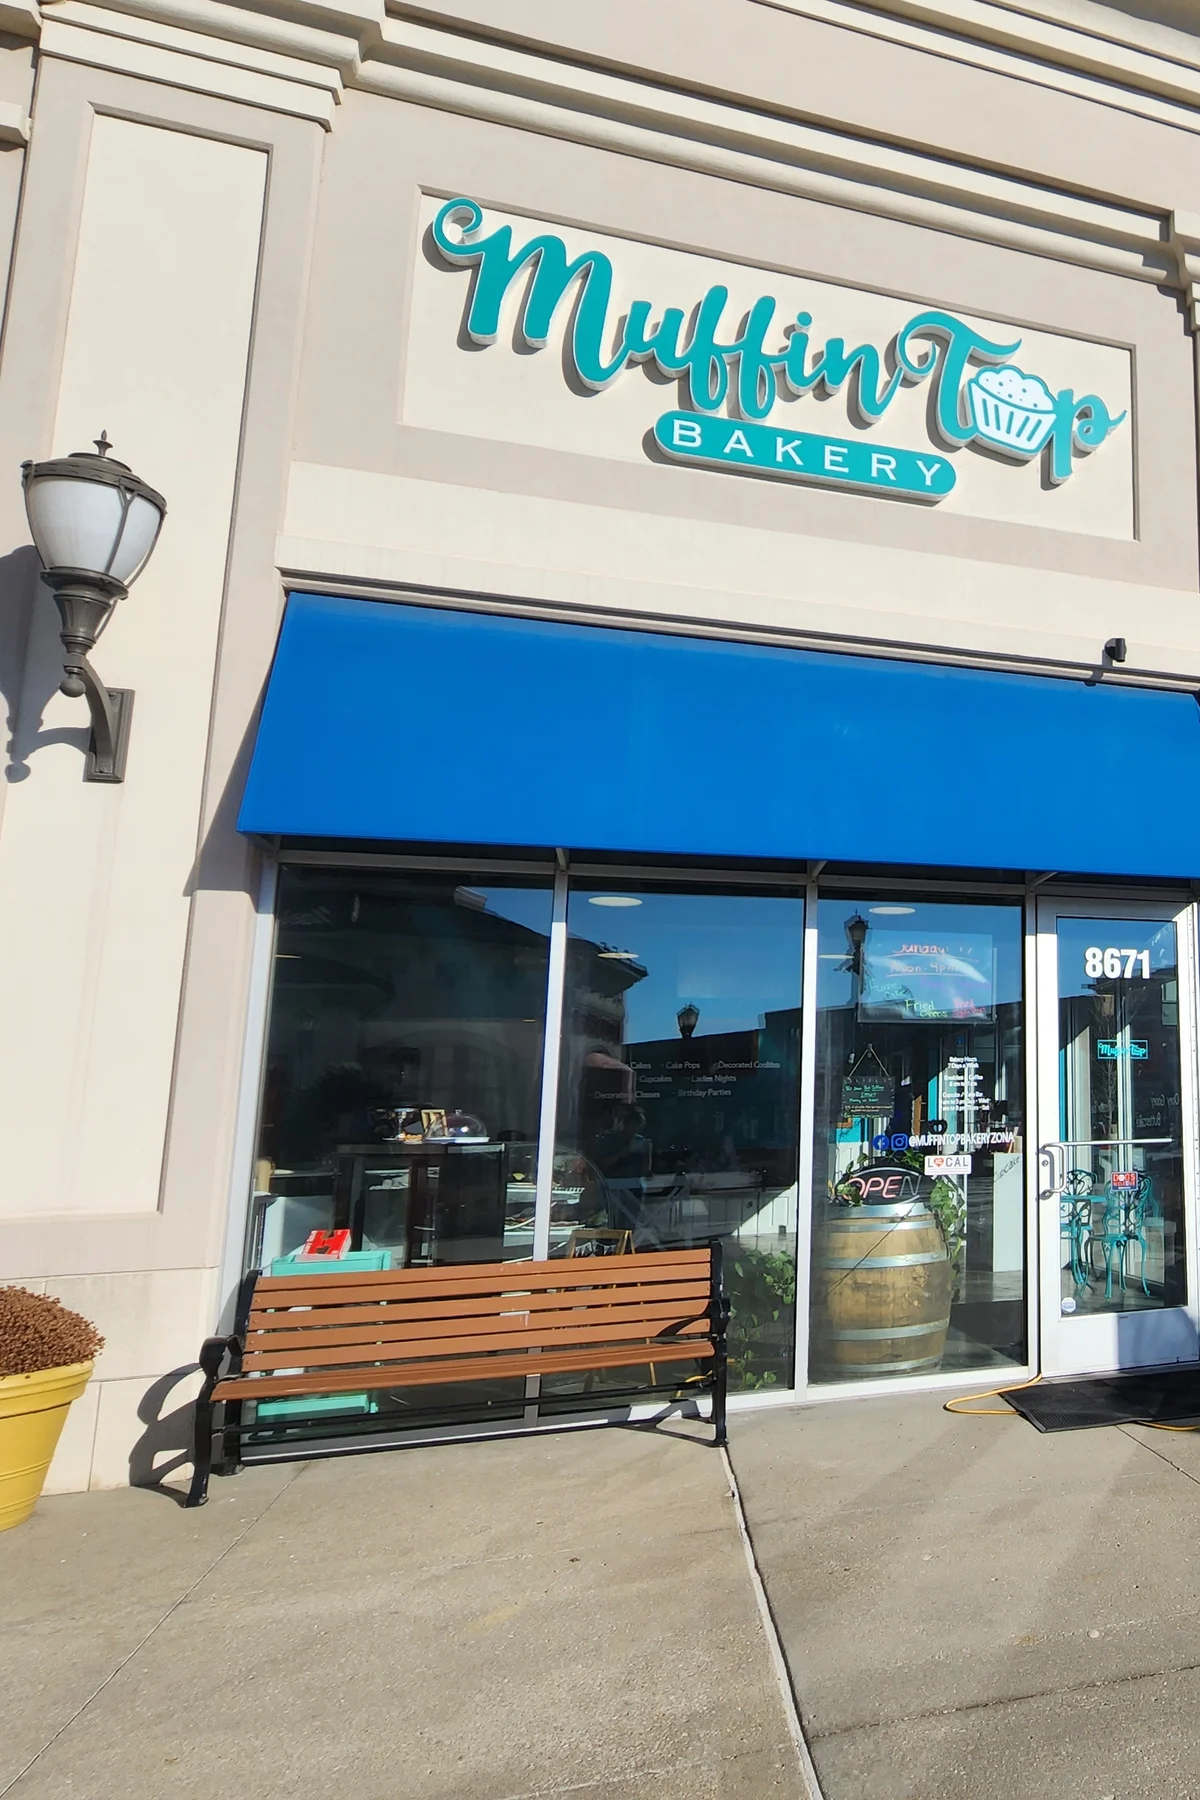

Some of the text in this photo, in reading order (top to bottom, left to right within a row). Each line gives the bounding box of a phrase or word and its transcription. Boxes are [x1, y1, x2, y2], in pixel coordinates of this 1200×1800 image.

[433, 197, 1128, 484] Muffin Top
[672, 420, 943, 488] BAKERY
[1084, 946, 1150, 979] 8671
[905, 1000, 935, 1011] Fried
[630, 1061, 652, 1069] Cakes
[665, 1061, 701, 1070] Cake Pops
[718, 1060, 752, 1069] Decorated
[639, 1074, 672, 1084] Cupcakes
[714, 1075, 737, 1084] Nights
[635, 1090, 661, 1099] Classes
[677, 1088, 732, 1098] Birthday Parties
[908, 1131, 1015, 1148] @MUFFINTOPBAKERYZONA
